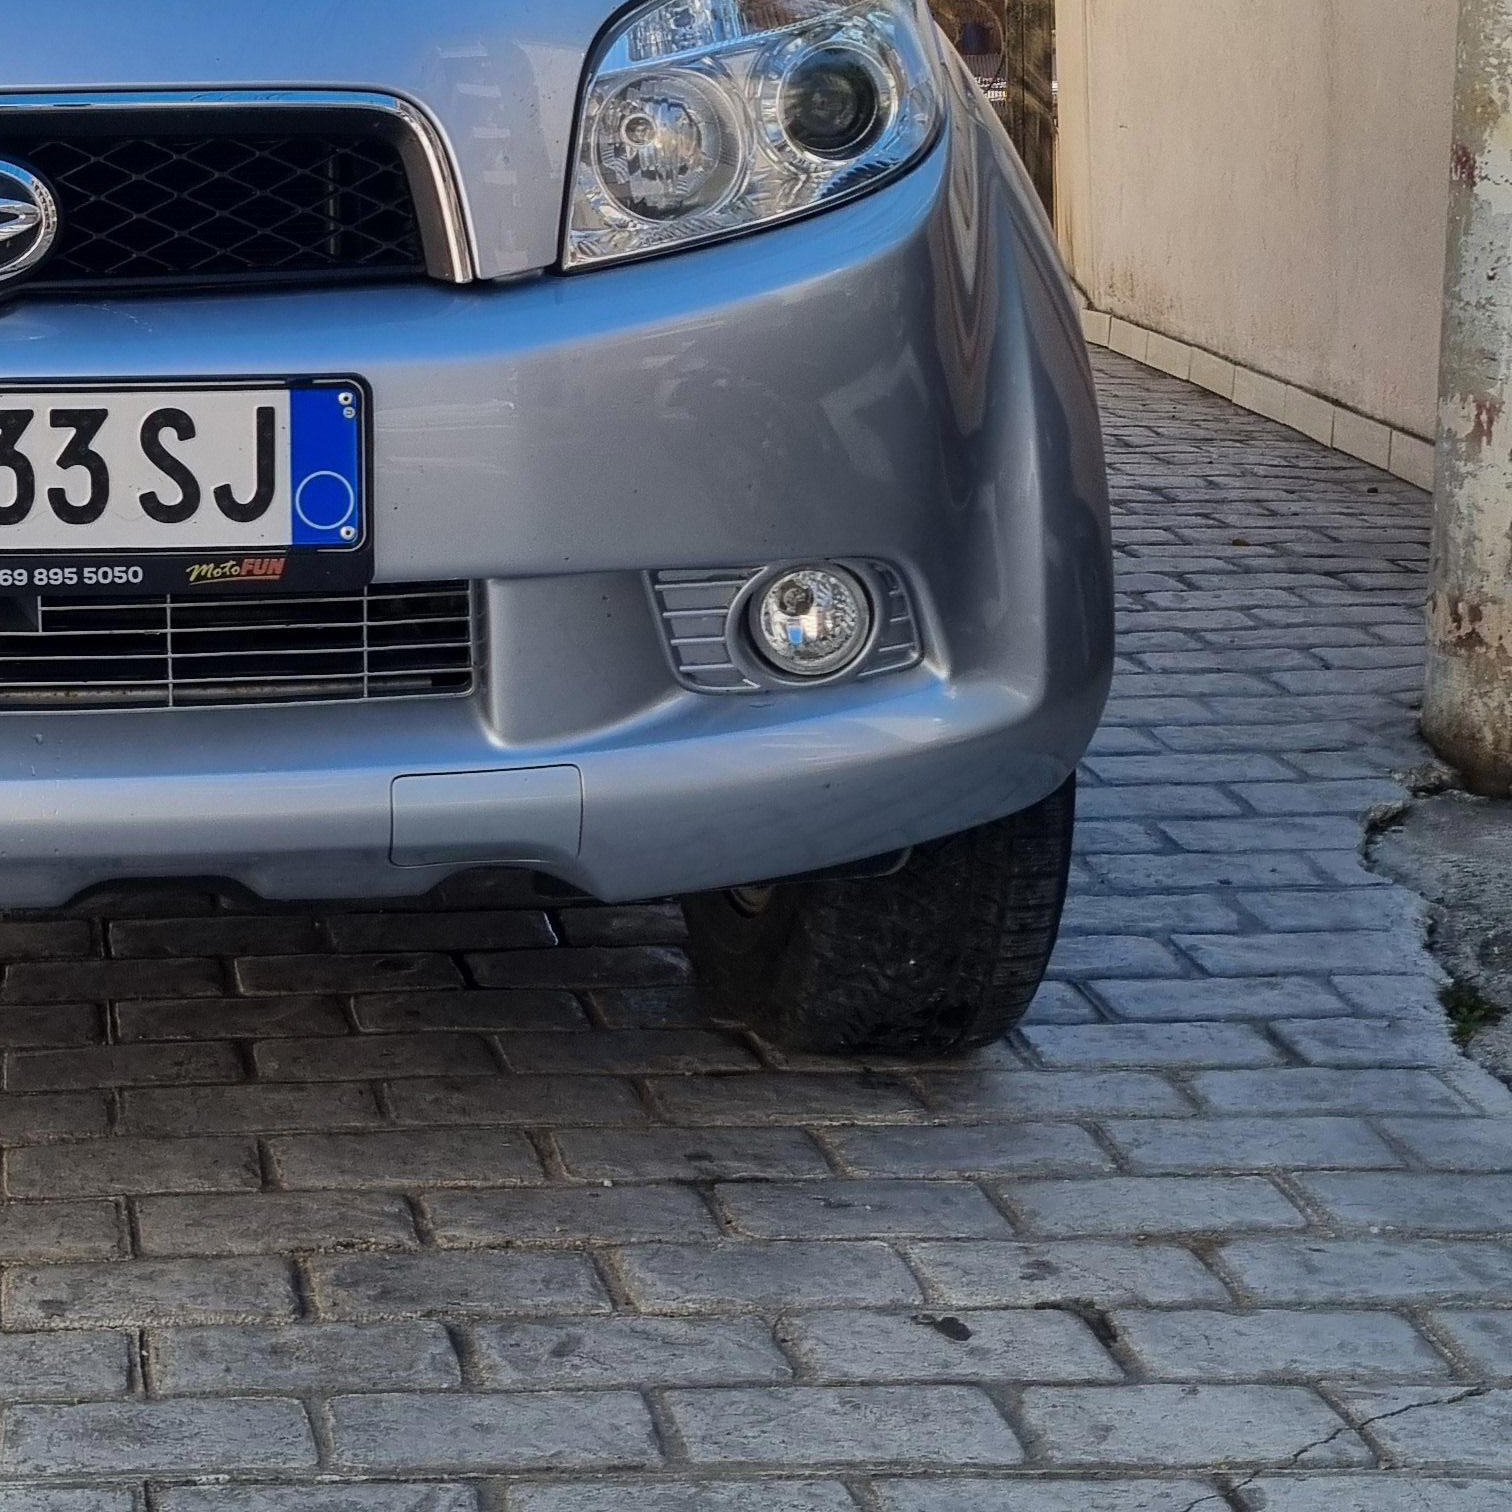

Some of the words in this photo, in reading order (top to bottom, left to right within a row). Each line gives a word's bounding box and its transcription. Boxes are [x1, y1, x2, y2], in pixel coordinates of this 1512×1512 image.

[137, 405, 277, 524] SJ
[32, 567, 79, 586] 895
[82, 565, 144, 584] 5050
